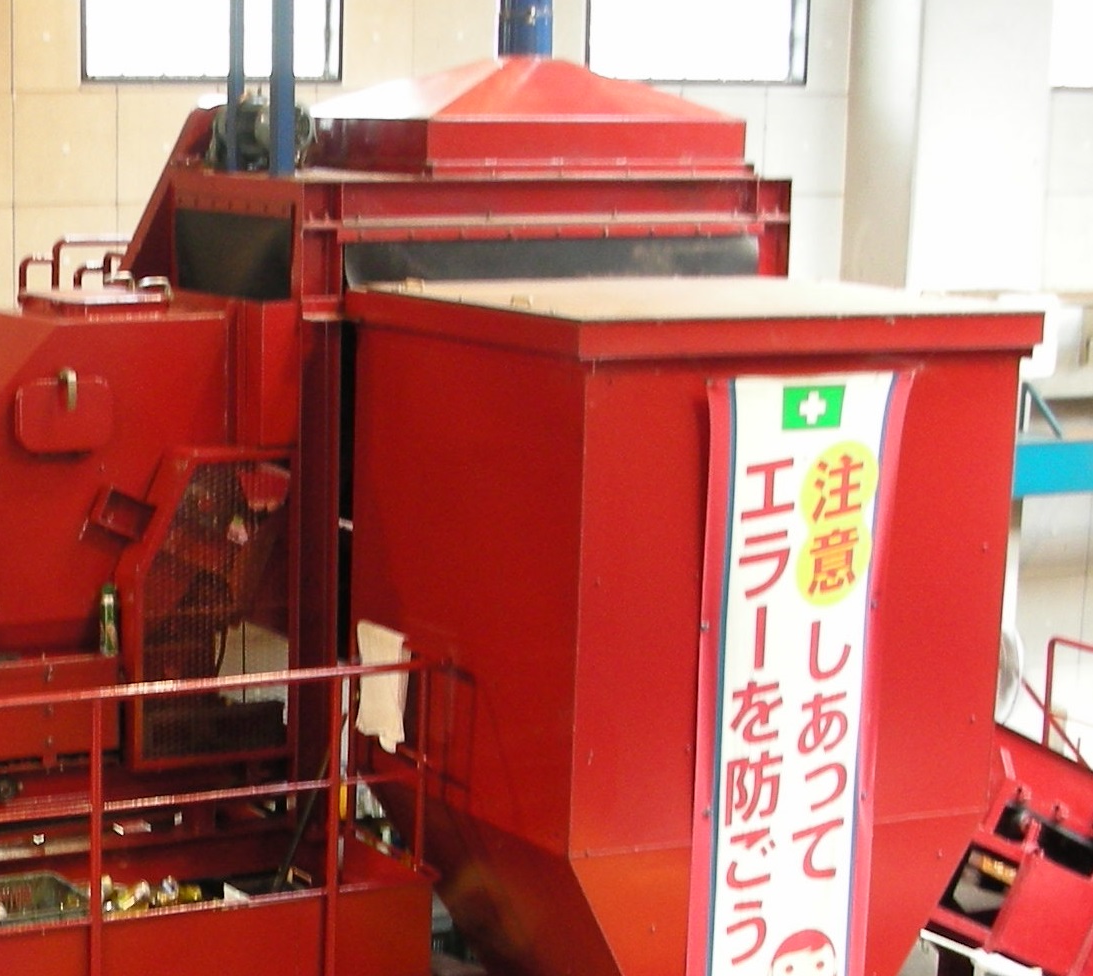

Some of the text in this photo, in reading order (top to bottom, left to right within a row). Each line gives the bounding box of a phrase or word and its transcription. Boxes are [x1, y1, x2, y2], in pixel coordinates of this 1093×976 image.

[725, 457, 795, 966] エラーを防ごう
